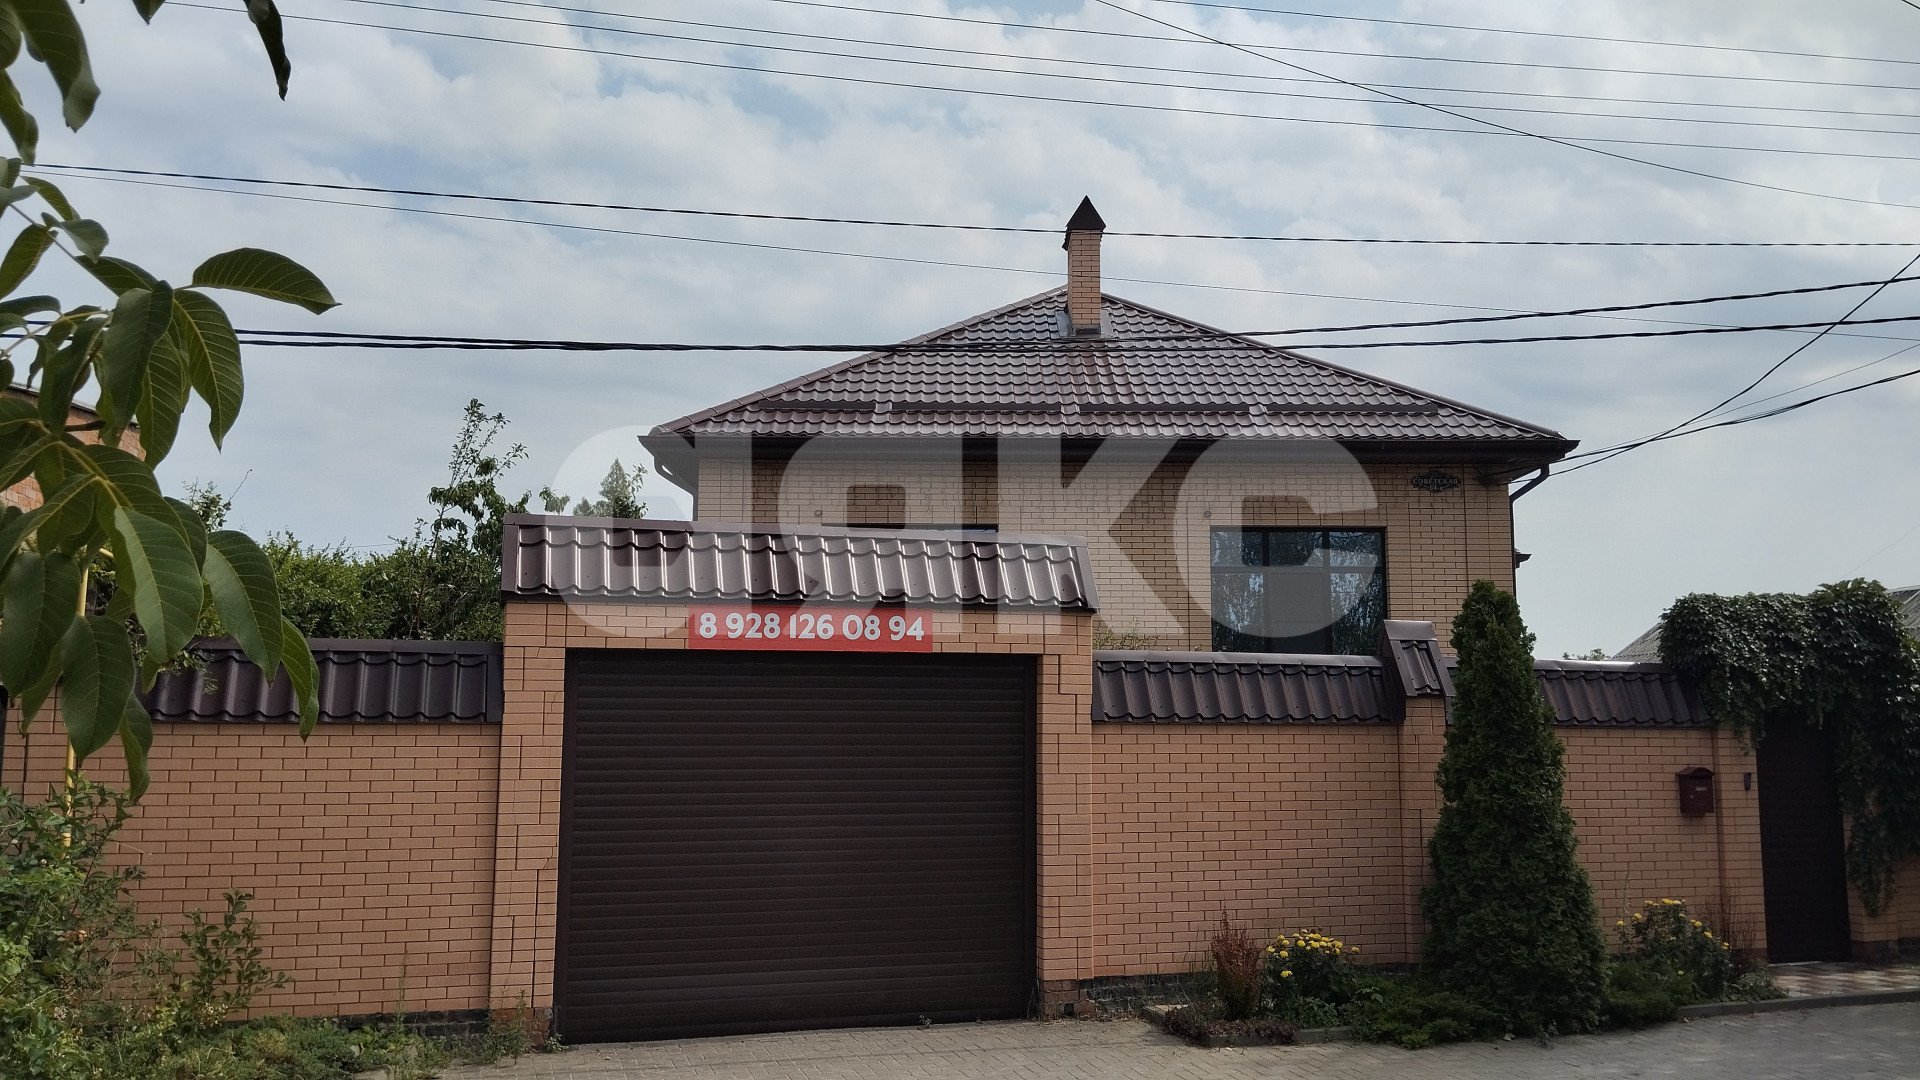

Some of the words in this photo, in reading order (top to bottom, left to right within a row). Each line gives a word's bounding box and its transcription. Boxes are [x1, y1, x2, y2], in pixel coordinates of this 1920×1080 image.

[700, 612, 717, 638] 8
[725, 612, 780, 639] 928
[789, 613, 834, 639] 126
[842, 614, 880, 640] 08
[889, 616, 924, 641] 94
